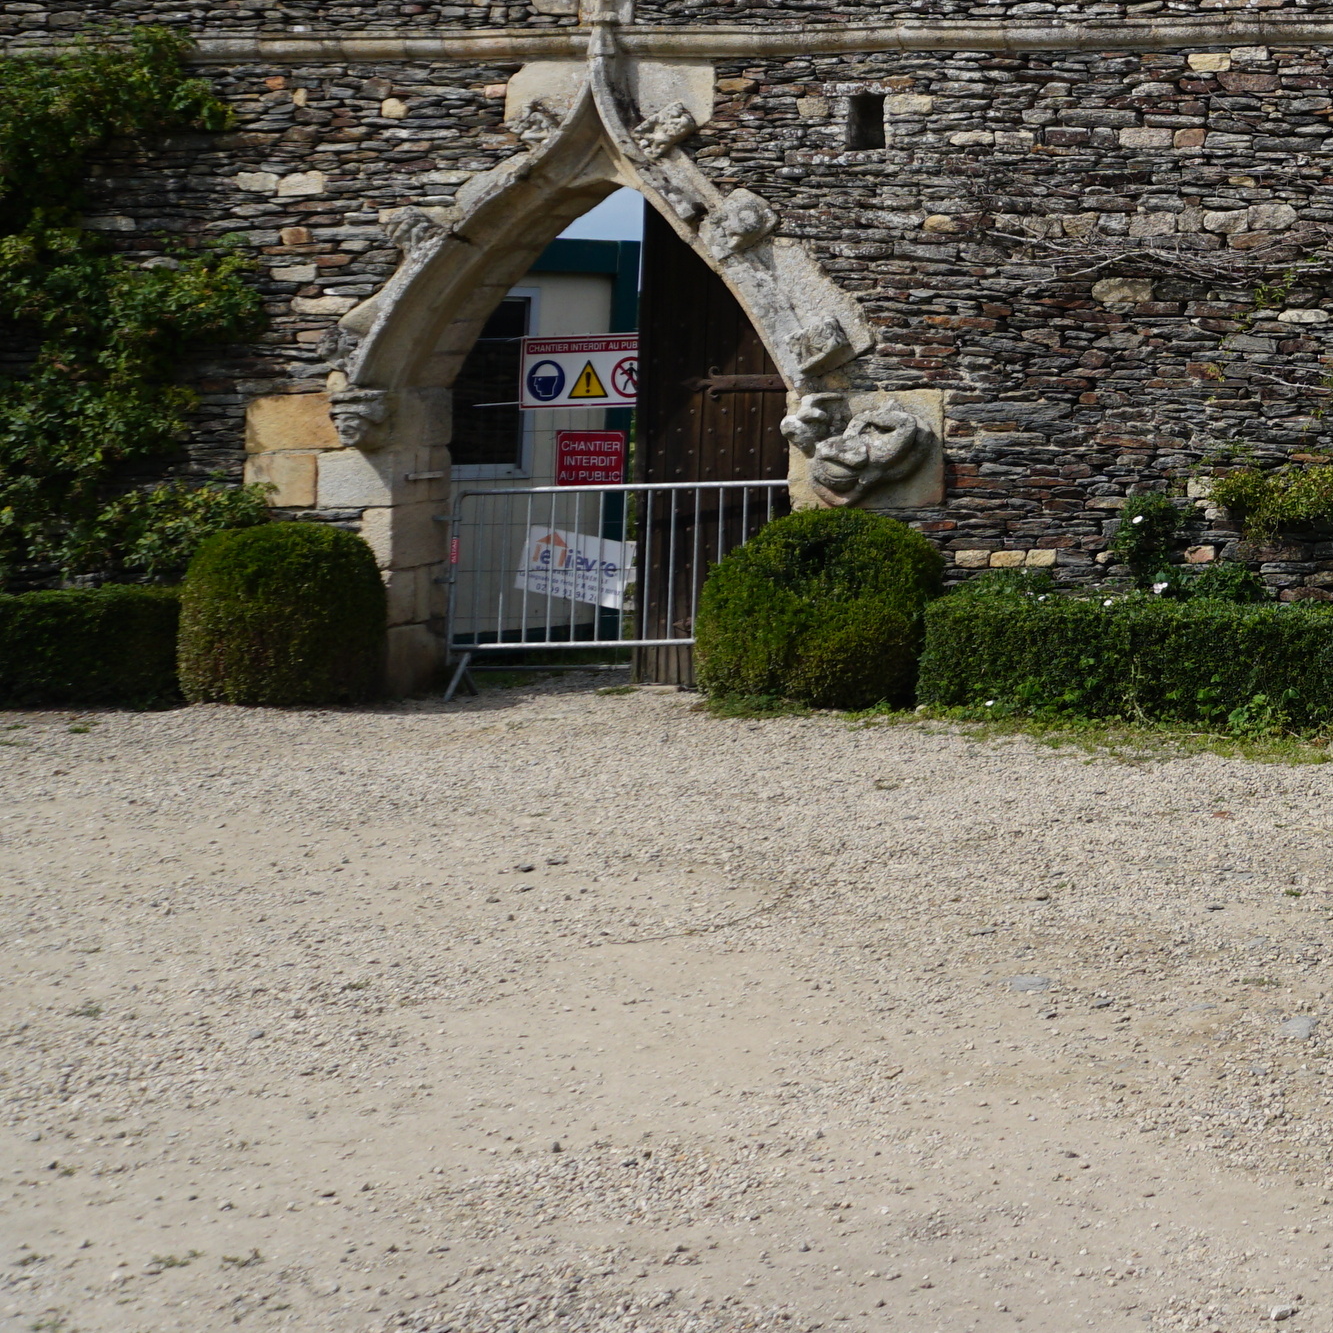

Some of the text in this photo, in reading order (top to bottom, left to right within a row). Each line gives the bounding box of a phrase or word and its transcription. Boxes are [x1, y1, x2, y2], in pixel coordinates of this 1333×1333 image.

[529, 343, 569, 353] CHANTIER
[570, 342, 606, 351] INTERDIT
[608, 341, 619, 350] AU
[561, 441, 620, 452] CHANTIER
[563, 455, 617, 466] INTERDIT
[559, 470, 620, 482] AU PUBLIC
